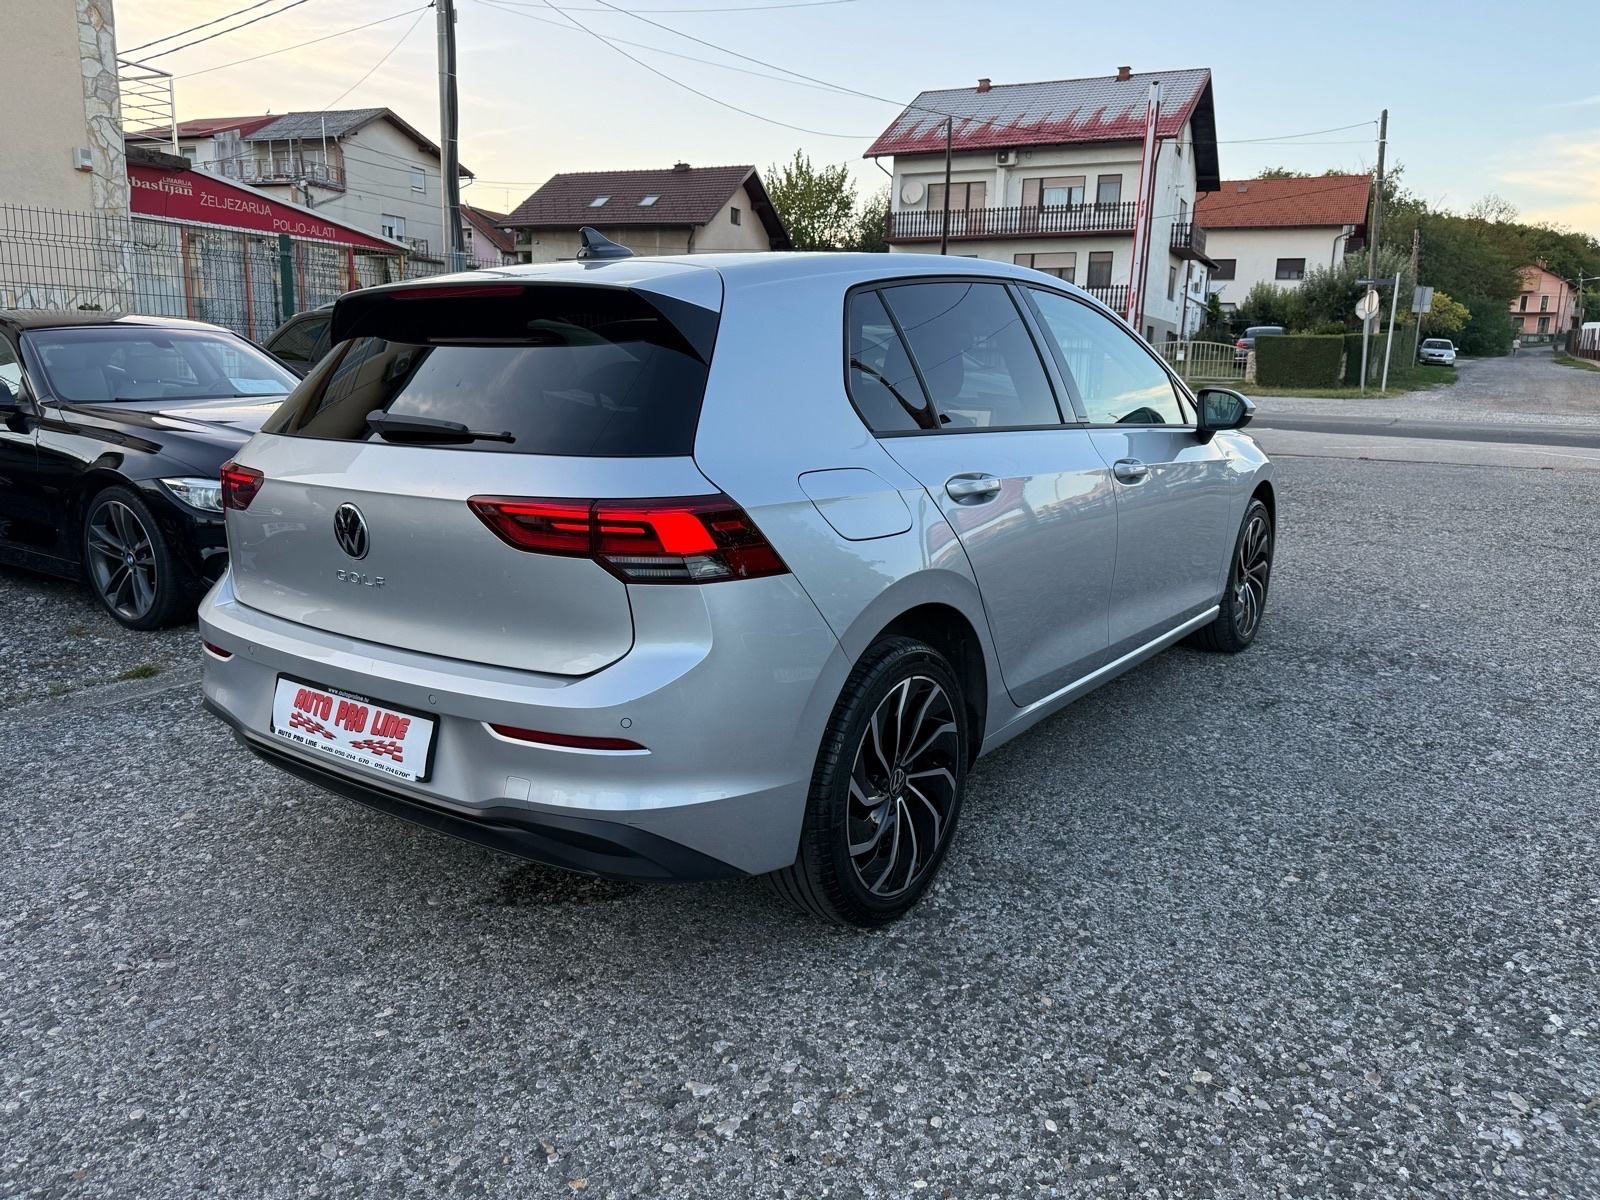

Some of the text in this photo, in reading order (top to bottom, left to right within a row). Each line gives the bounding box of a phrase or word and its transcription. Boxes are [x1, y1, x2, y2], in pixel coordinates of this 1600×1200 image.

[162, 176, 193, 187] LIMARIJA
[199, 191, 273, 217] ŽELJEZARIJA
[272, 218, 336, 239] POLJO-ALATI
[336, 568, 386, 588] GOLF
[293, 688, 411, 741] AUTO PRO LINE
[277, 729, 292, 739] AUTO
[292, 734, 304, 743] PRO
[305, 738, 318, 748] LINE
